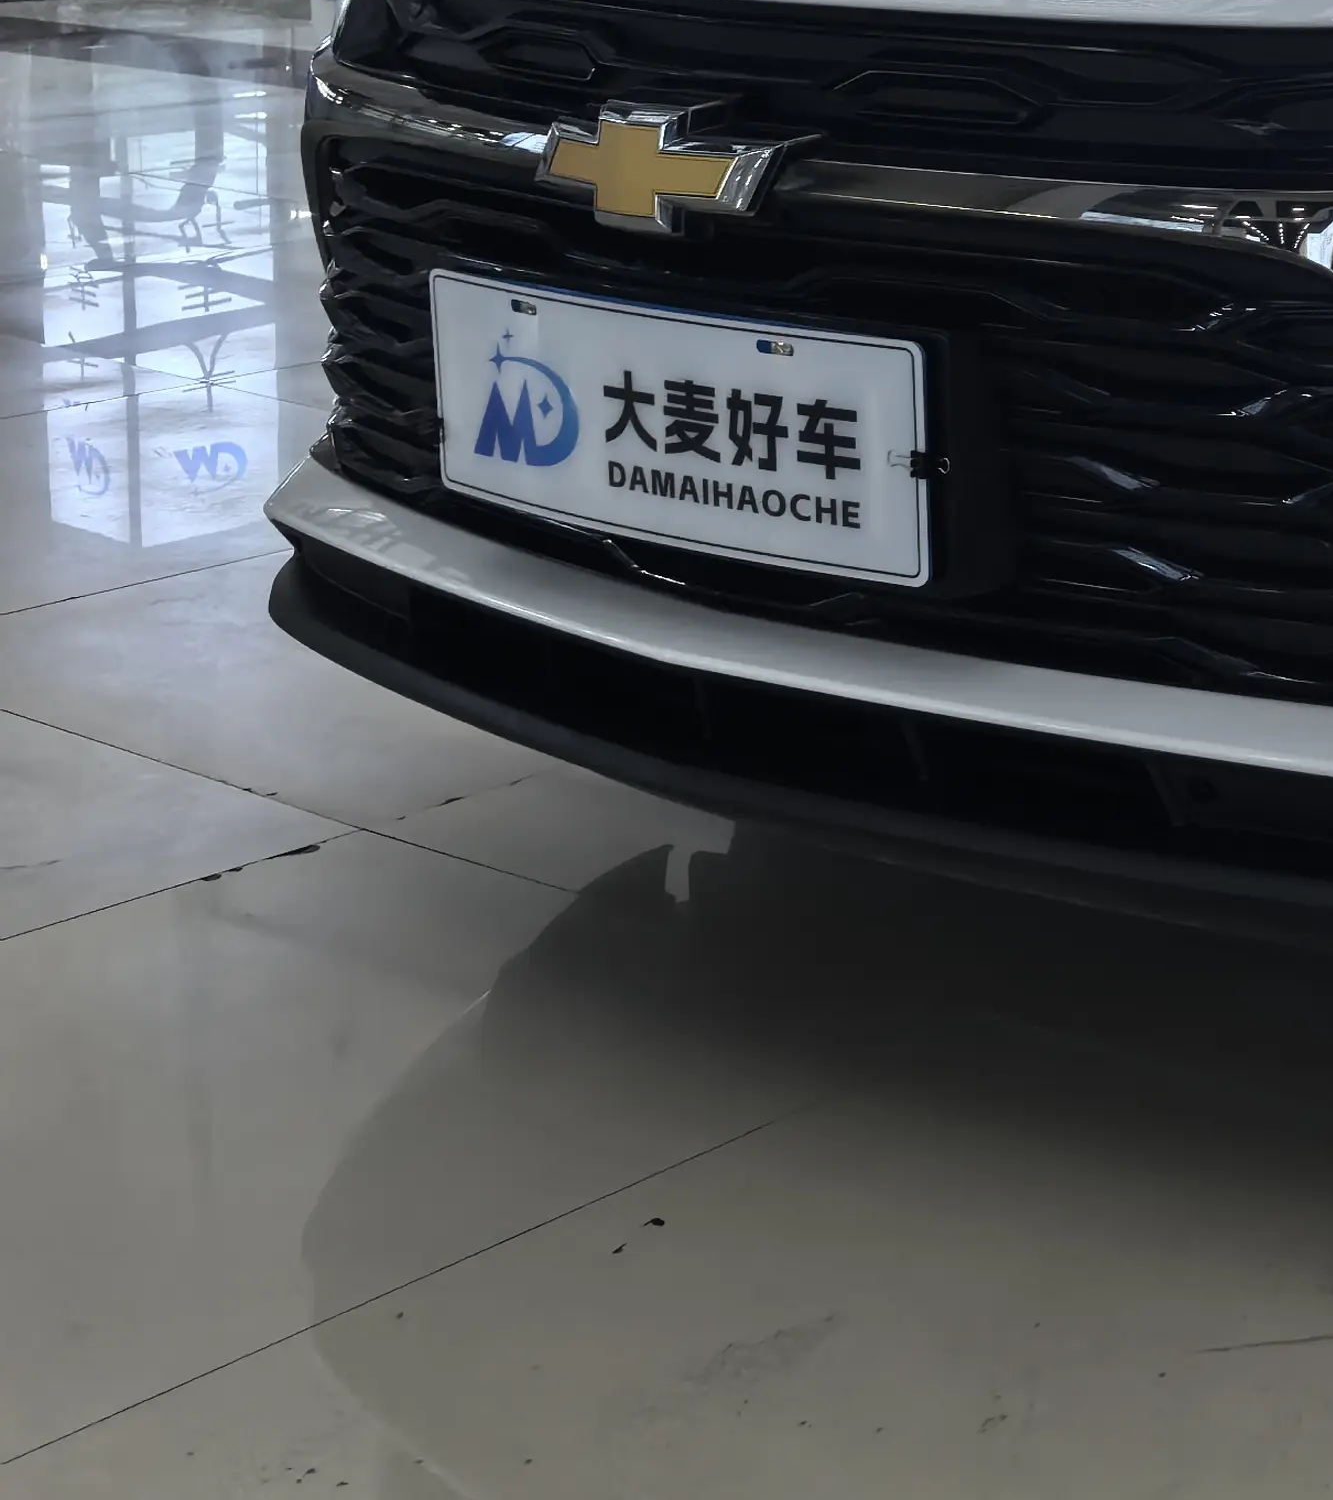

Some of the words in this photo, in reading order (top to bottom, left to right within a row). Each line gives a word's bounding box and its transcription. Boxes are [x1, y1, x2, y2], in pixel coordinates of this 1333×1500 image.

[602, 370, 861, 480] 大麦好车
[607, 460, 862, 530] DAMAIHAOCHE
